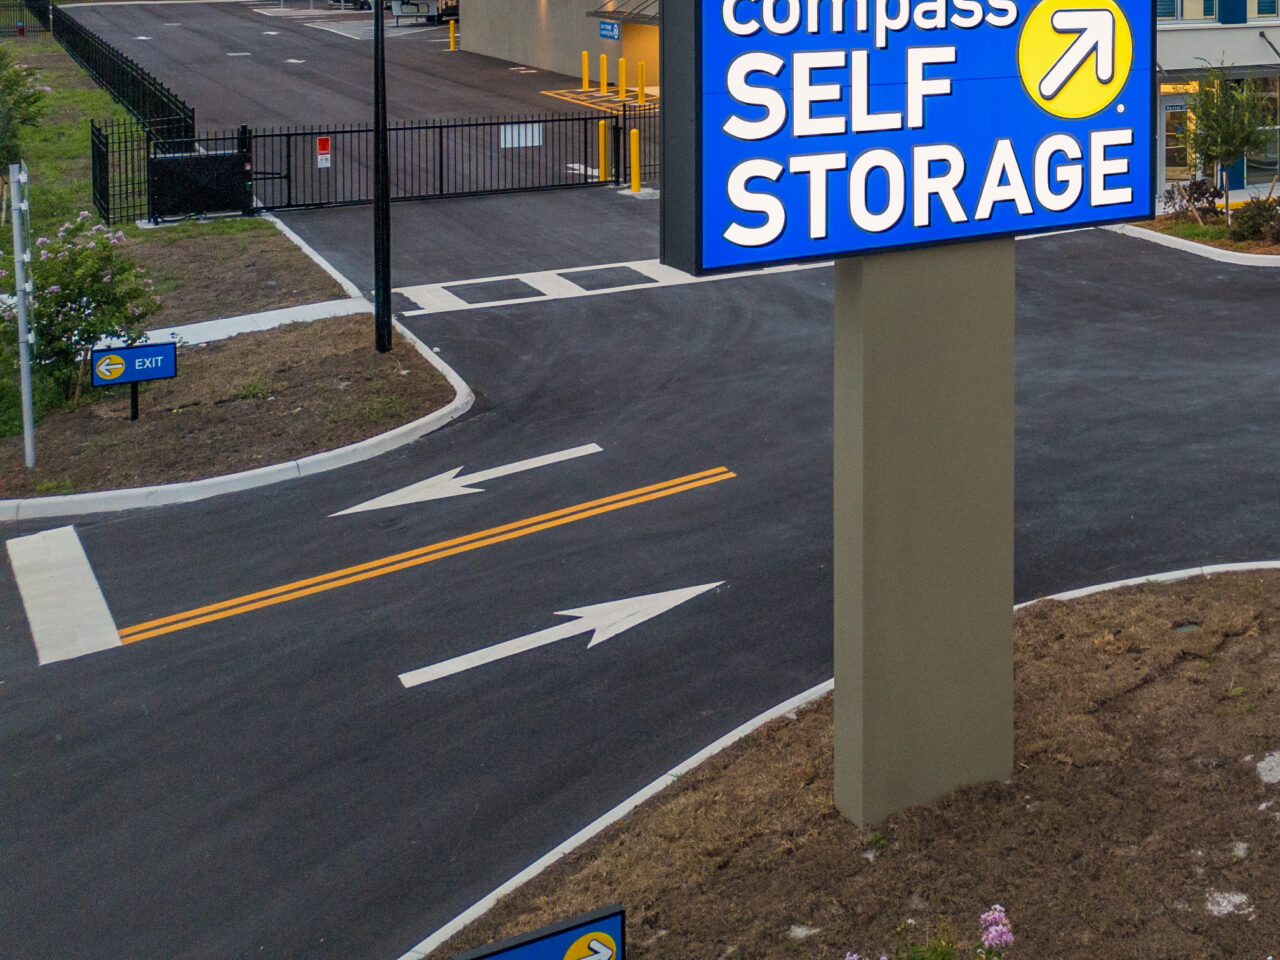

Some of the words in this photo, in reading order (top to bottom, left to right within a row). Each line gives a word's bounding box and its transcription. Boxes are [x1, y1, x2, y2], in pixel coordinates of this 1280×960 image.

[722, 46, 957, 140] SELF
[723, 128, 1134, 246] STORAGE
[135, 356, 163, 369] EXIT
